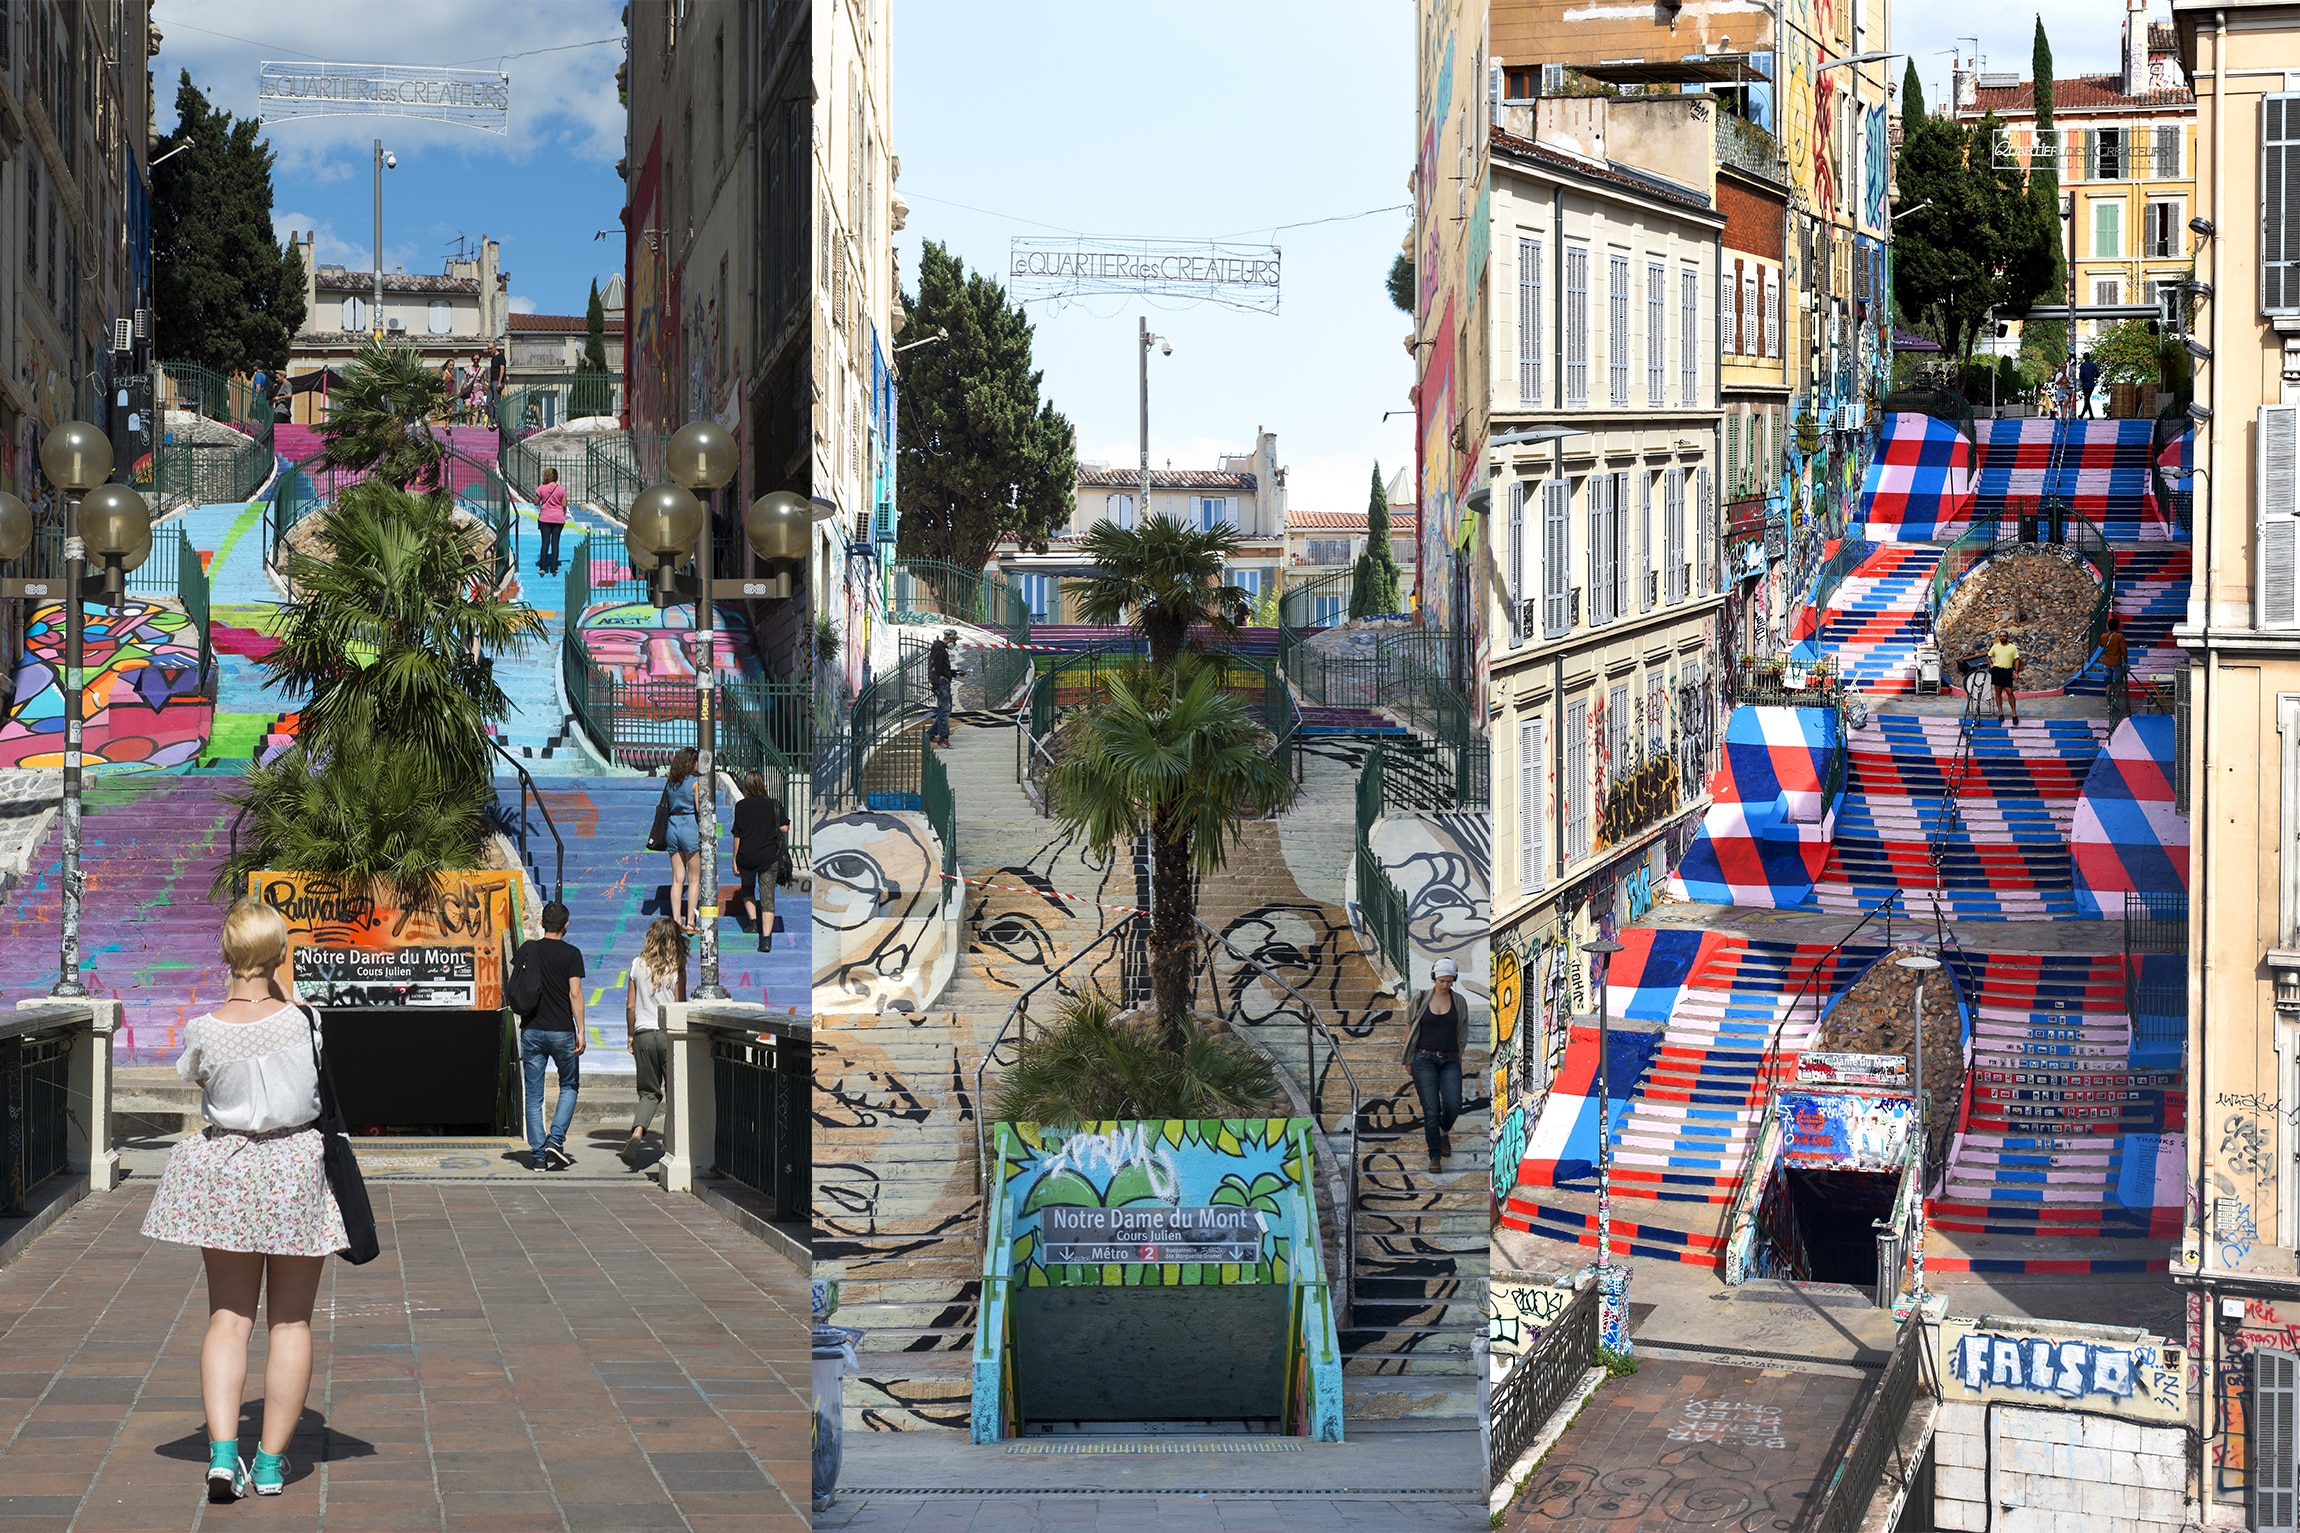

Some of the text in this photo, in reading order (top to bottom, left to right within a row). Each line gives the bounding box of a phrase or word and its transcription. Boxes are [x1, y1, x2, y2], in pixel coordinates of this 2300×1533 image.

[1028, 251, 1130, 279] QUARTIER
[1129, 256, 1160, 280] des
[1160, 256, 1280, 287] CREATEURS
[301, 949, 466, 965] Notre Dame du Mont
[356, 966, 411, 977] Cours Julien
[1053, 1207, 1247, 1229] Notre Dame du Mont
[1116, 1230, 1182, 1242] Cours Julien
[1091, 1247, 1129, 1260] Métro
[1144, 1247, 1154, 1260] 2
[1962, 1333, 2133, 1399] FALSO
